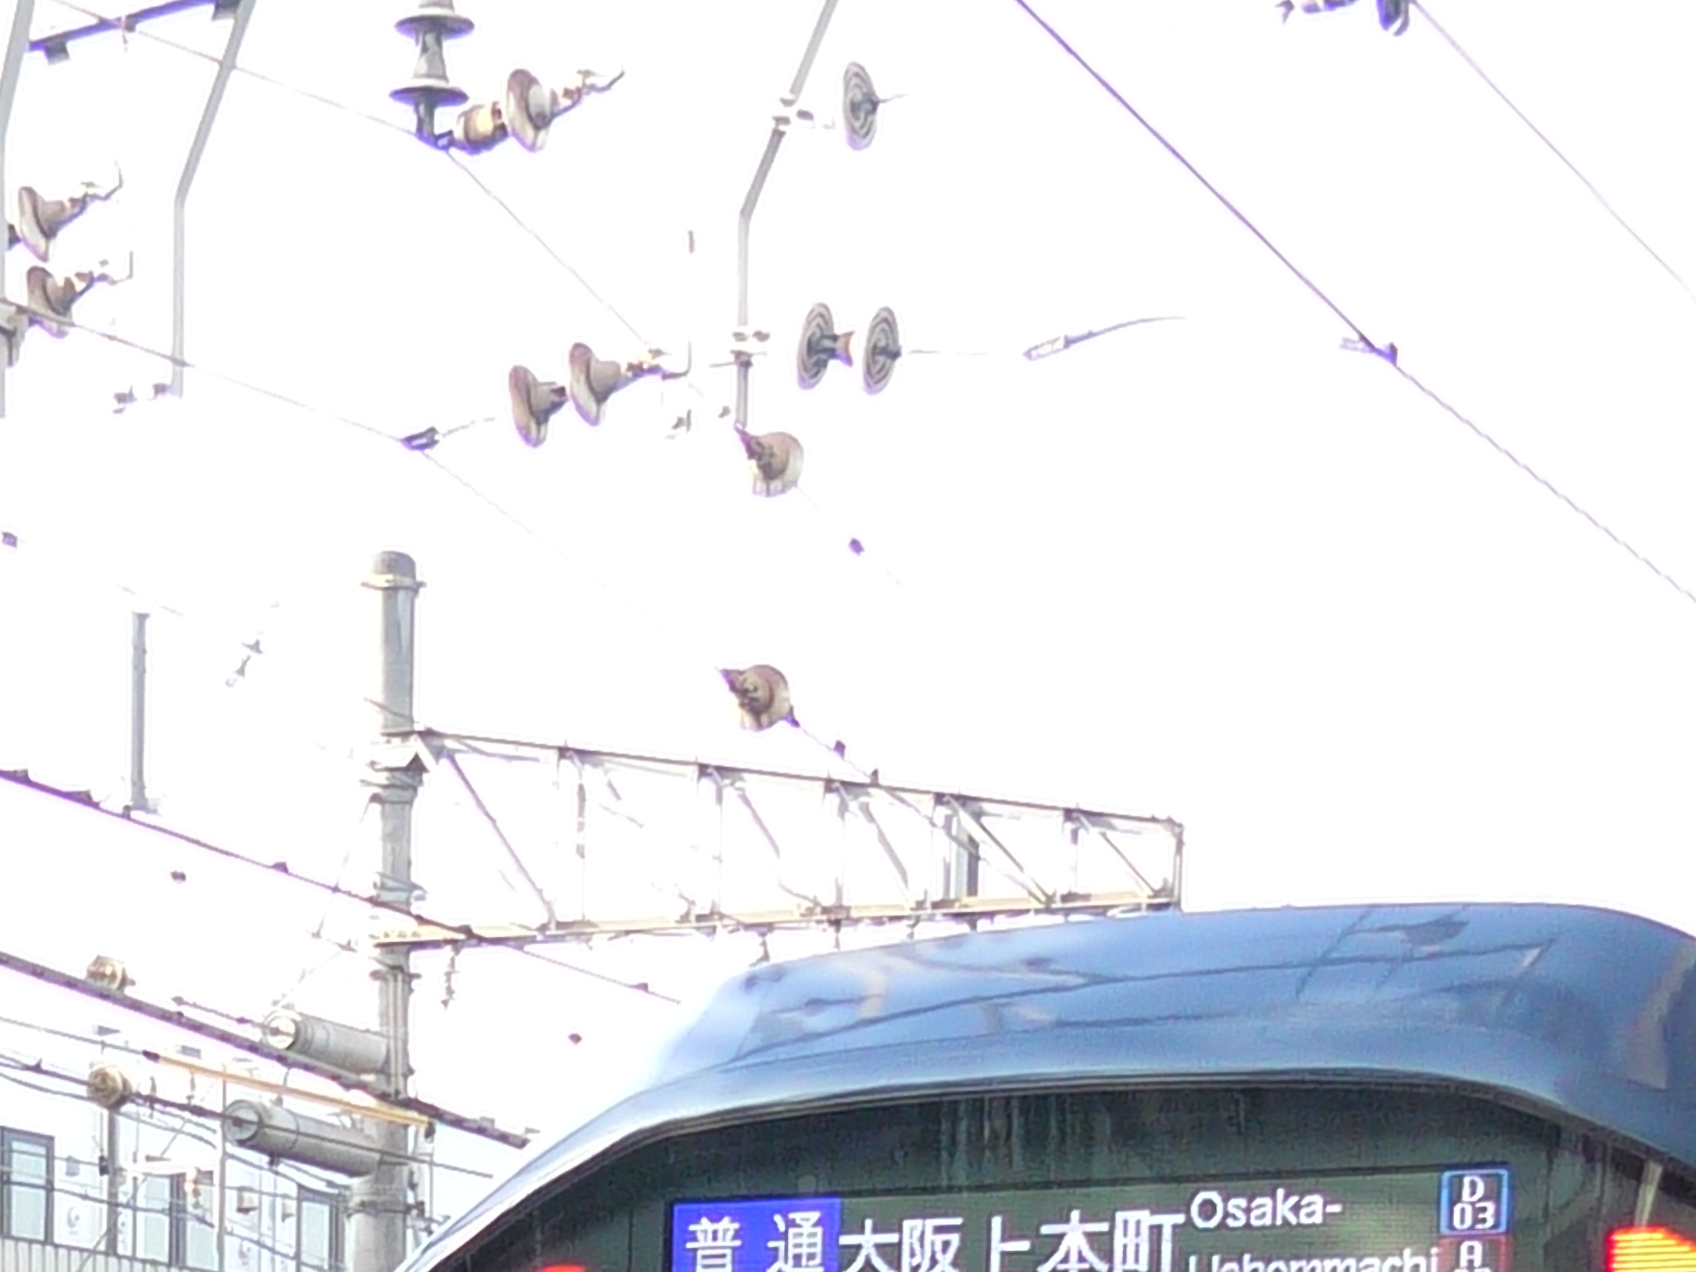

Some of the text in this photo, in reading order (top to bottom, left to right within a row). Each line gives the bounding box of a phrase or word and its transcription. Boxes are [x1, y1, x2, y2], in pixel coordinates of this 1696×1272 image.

[1461, 1175, 1485, 1203] D
[1189, 1187, 1343, 1229] Osaka-
[1452, 1201, 1496, 1231] 03
[1460, 1240, 1483, 1267] A
